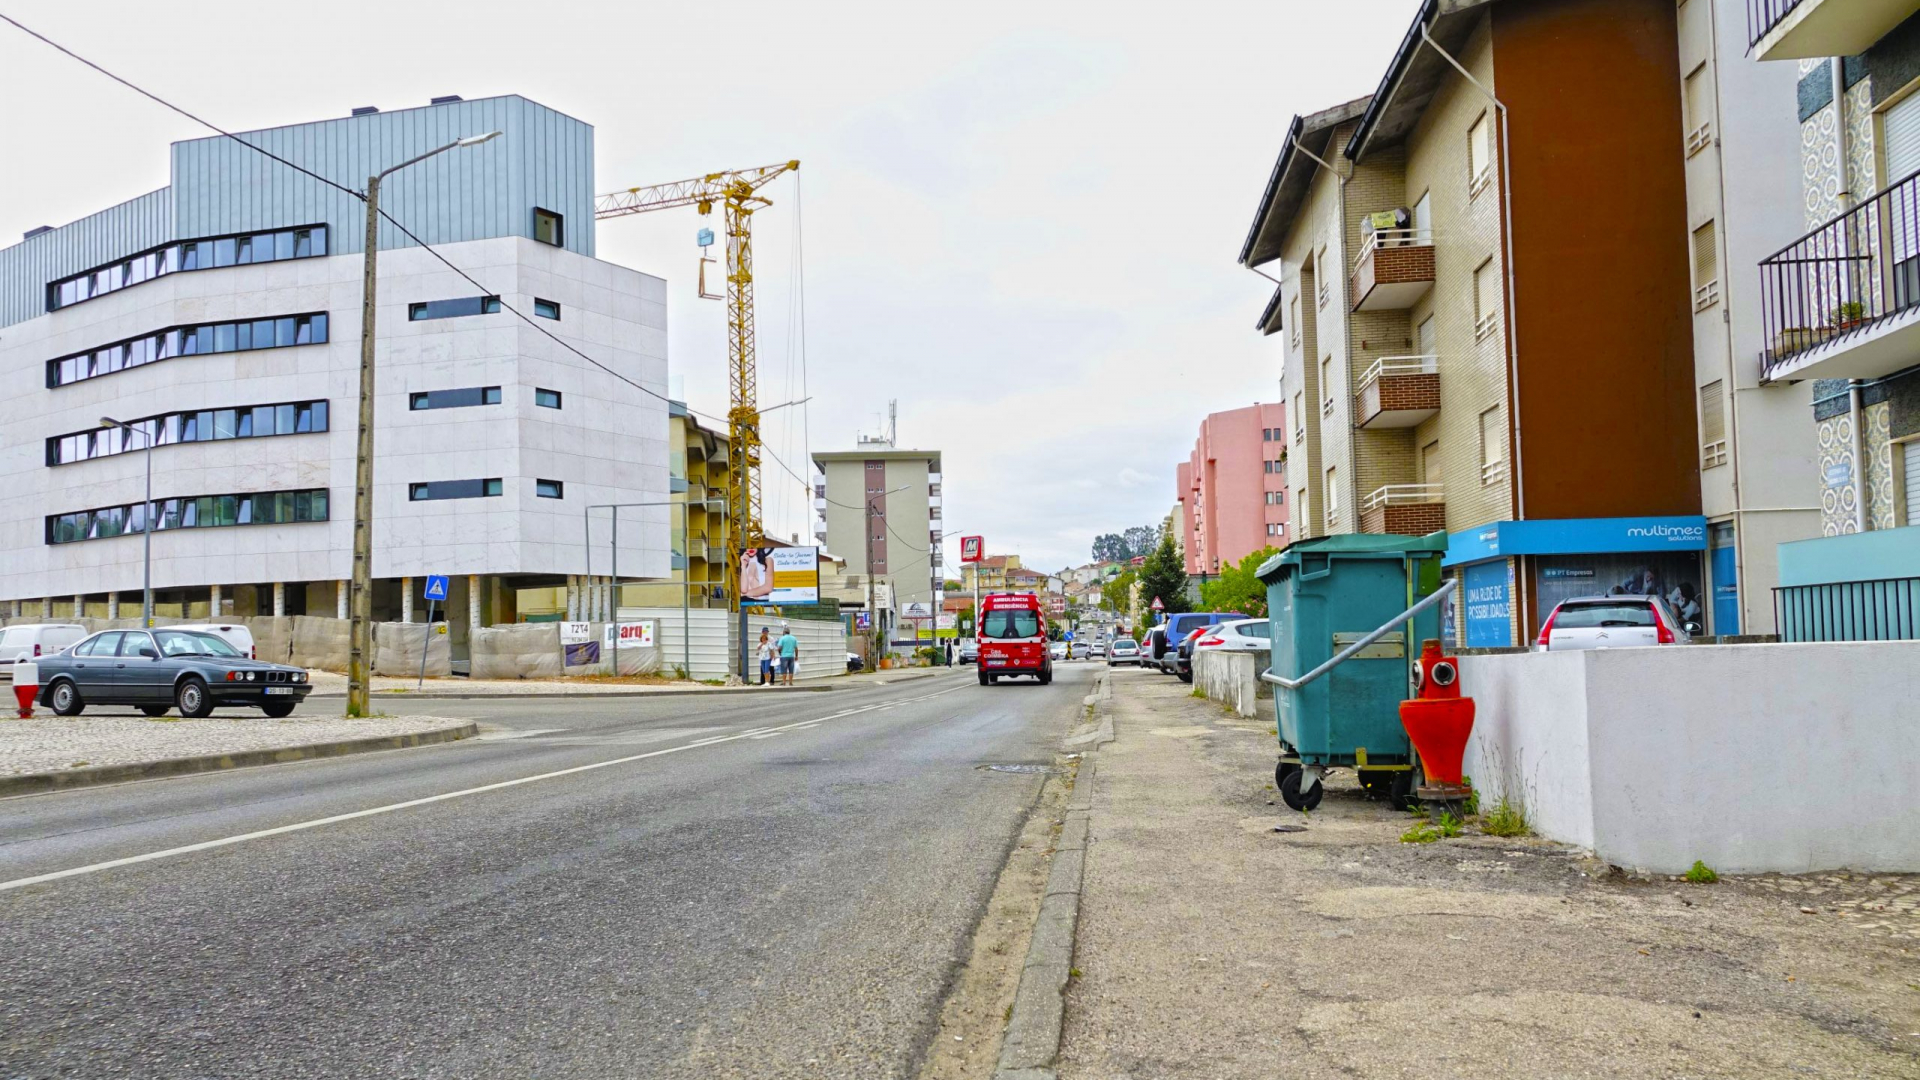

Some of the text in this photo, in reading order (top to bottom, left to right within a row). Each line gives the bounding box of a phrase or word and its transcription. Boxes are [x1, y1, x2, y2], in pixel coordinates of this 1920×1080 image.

[1627, 525, 1703, 536] multimec
[1565, 569, 1593, 577] Empresas
[1467, 588, 1480, 603] UMA
[1494, 585, 1502, 600] DE
